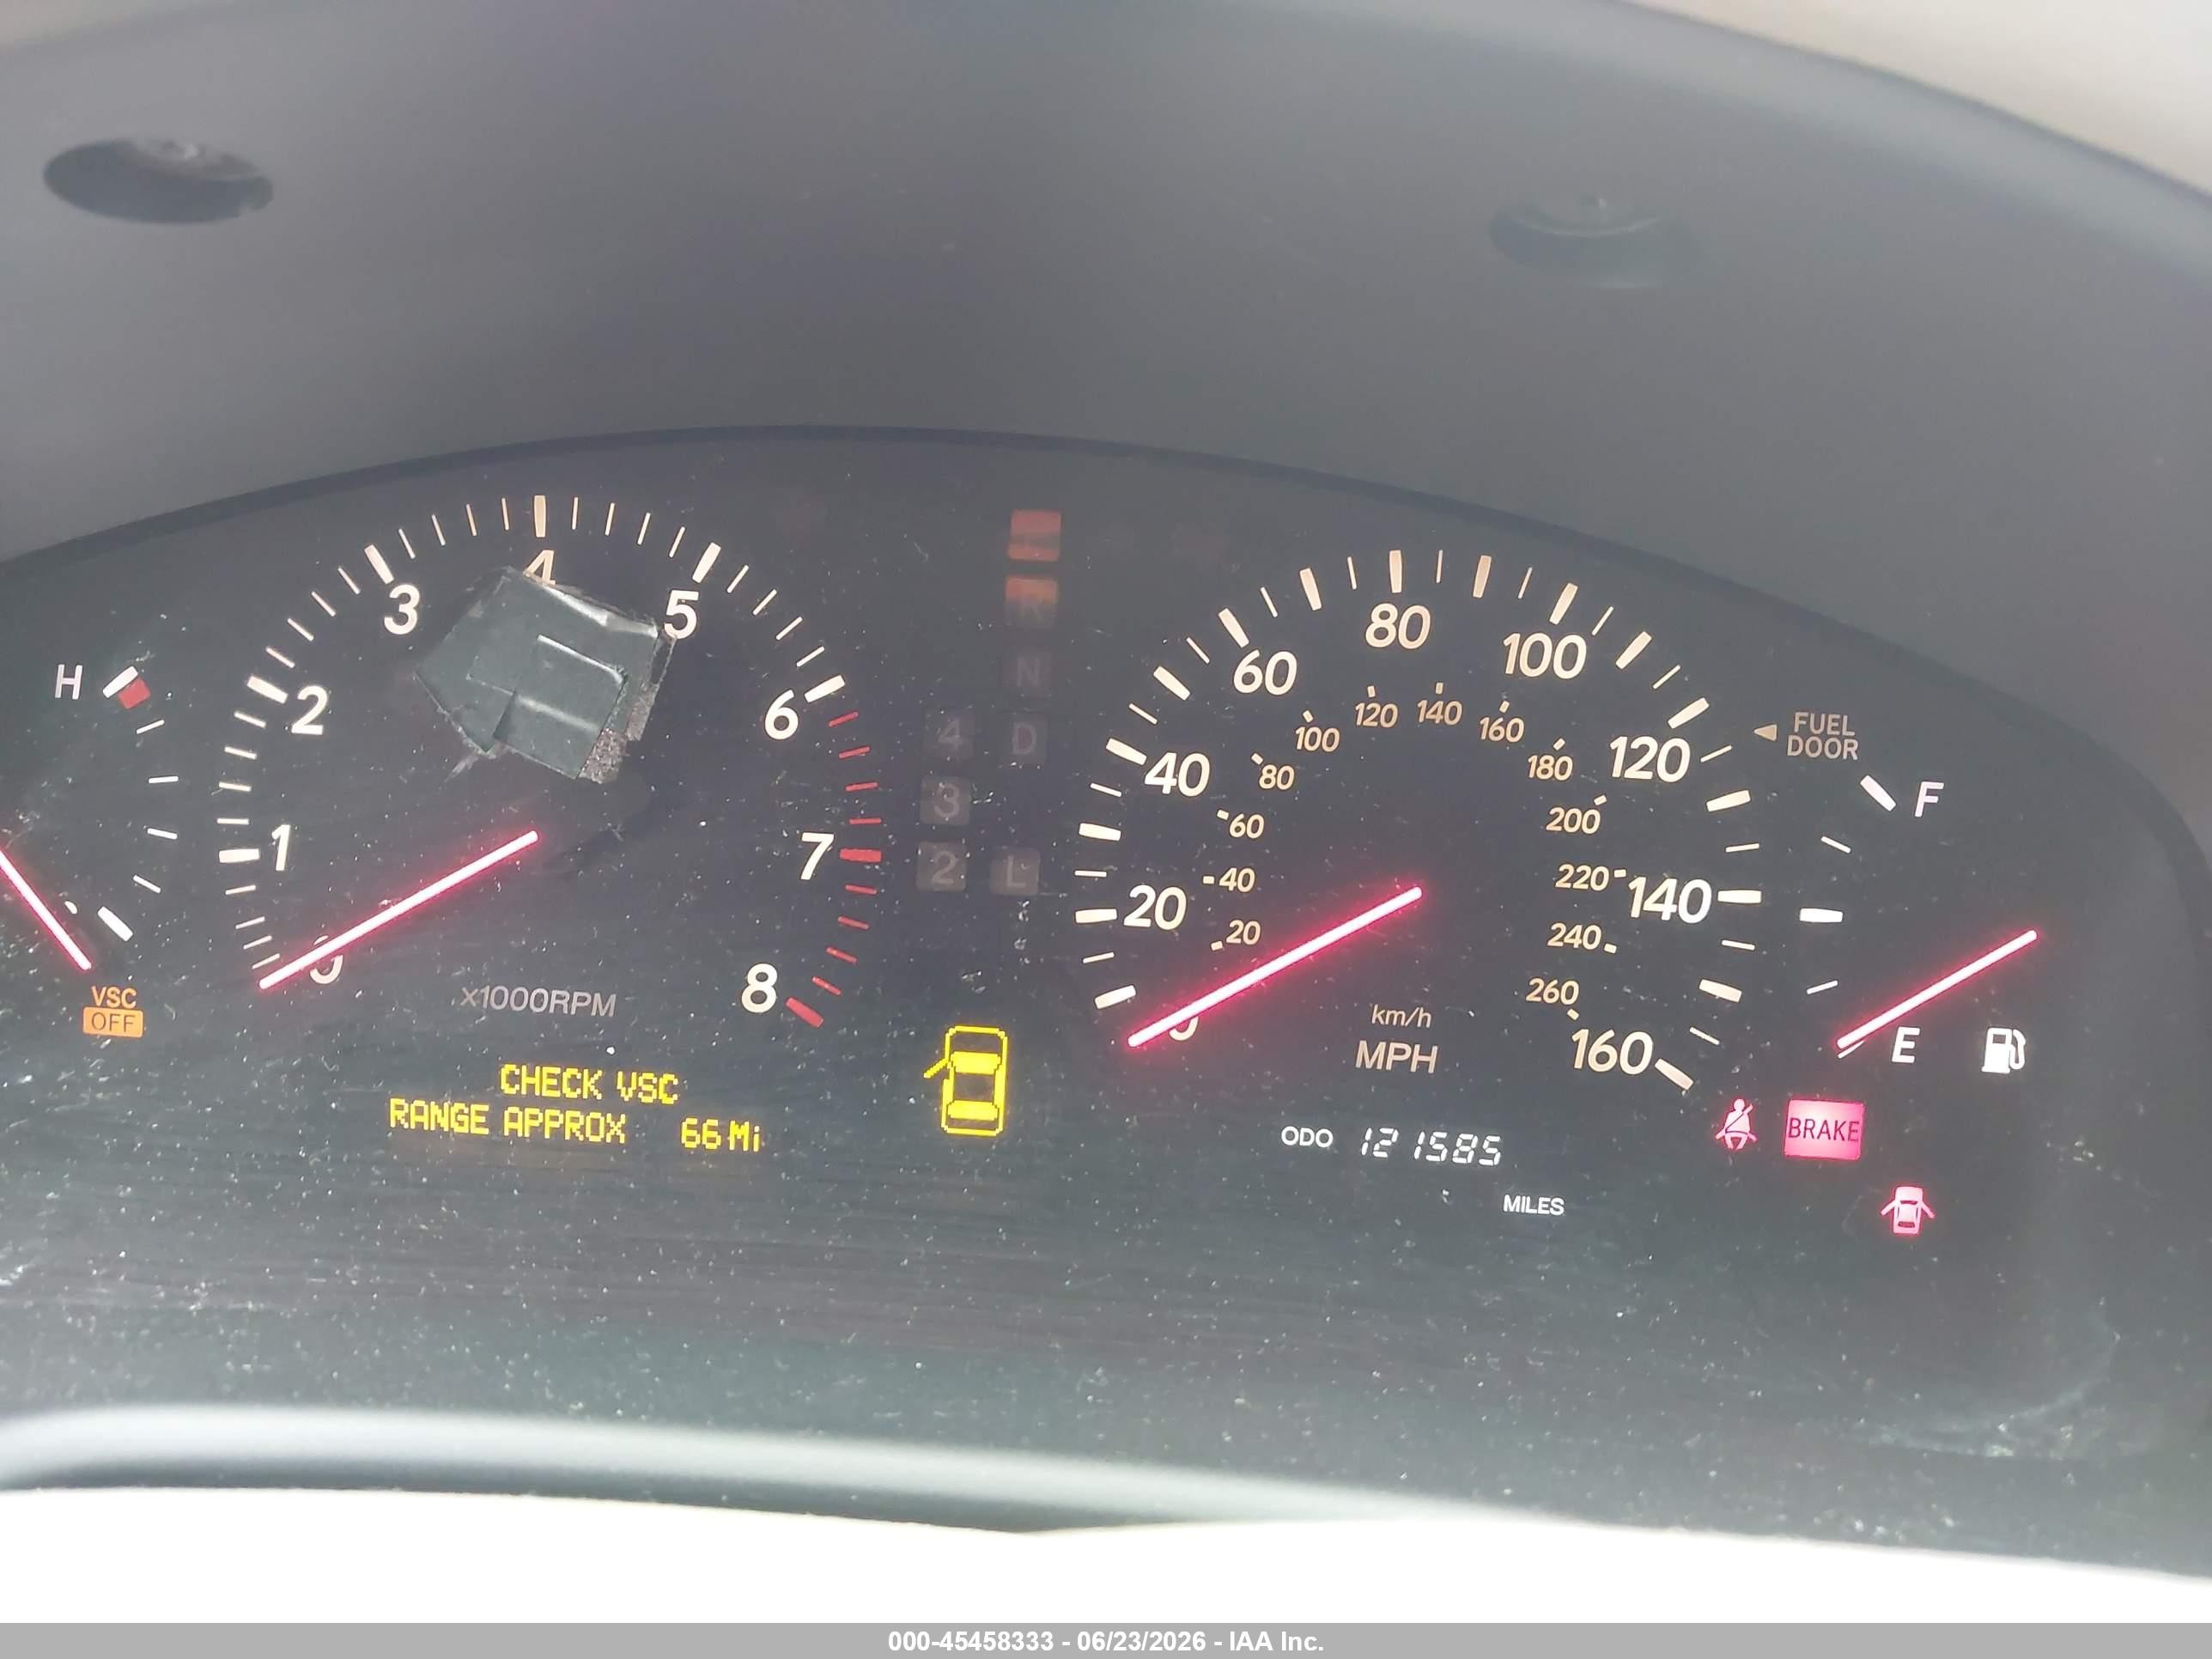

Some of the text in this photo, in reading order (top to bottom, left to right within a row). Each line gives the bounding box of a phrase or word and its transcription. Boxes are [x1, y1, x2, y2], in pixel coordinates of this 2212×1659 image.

[383, 584, 420, 635] 3
[664, 589, 699, 641] 5
[1365, 603, 1431, 649] 80
[1233, 649, 1297, 696] 60
[1503, 632, 1587, 679] 100
[54, 664, 83, 700] H
[291, 684, 328, 736] 2
[764, 690, 799, 740] 6
[1355, 702, 1398, 728] 120
[1417, 700, 1462, 726] 140
[1793, 712, 1856, 737] FUEL
[1295, 726, 1340, 752] 100
[1480, 716, 1524, 743] 160
[1609, 736, 1691, 783] 120
[1787, 736, 1859, 761] DOOR
[1144, 752, 1210, 797] 40
[1258, 765, 1295, 790] 80
[1528, 755, 1573, 781] 180
[1914, 781, 1945, 817] F
[1229, 813, 1265, 839] 60
[1546, 806, 1601, 835] 200
[271, 823, 291, 872] 1
[800, 832, 835, 880] 7
[1218, 867, 1255, 893] 40
[1555, 864, 1610, 891] 220
[1123, 884, 1187, 931] 20
[1628, 876, 1712, 924] 140
[1225, 920, 1261, 945] 20
[1547, 922, 1601, 950] 240
[91, 985, 137, 1009] VSC
[741, 963, 778, 1013] 8
[1525, 977, 1579, 1006] 260
[91, 1013, 136, 1032] OFF
[1371, 1004, 1431, 1028] km/h
[1355, 1040, 1438, 1073] MPH
[1571, 1029, 1654, 1075] 160
[1891, 1026, 1921, 1064] E
[501, 1063, 678, 1105] CHECK VSC
[390, 1097, 489, 1135] RANGE
[503, 1106, 626, 1144] APPROX
[1788, 1118, 1861, 1142] BRAKE
[1281, 1126, 1501, 1166] ODO 121585
[1503, 1194, 1565, 1216] MILES
